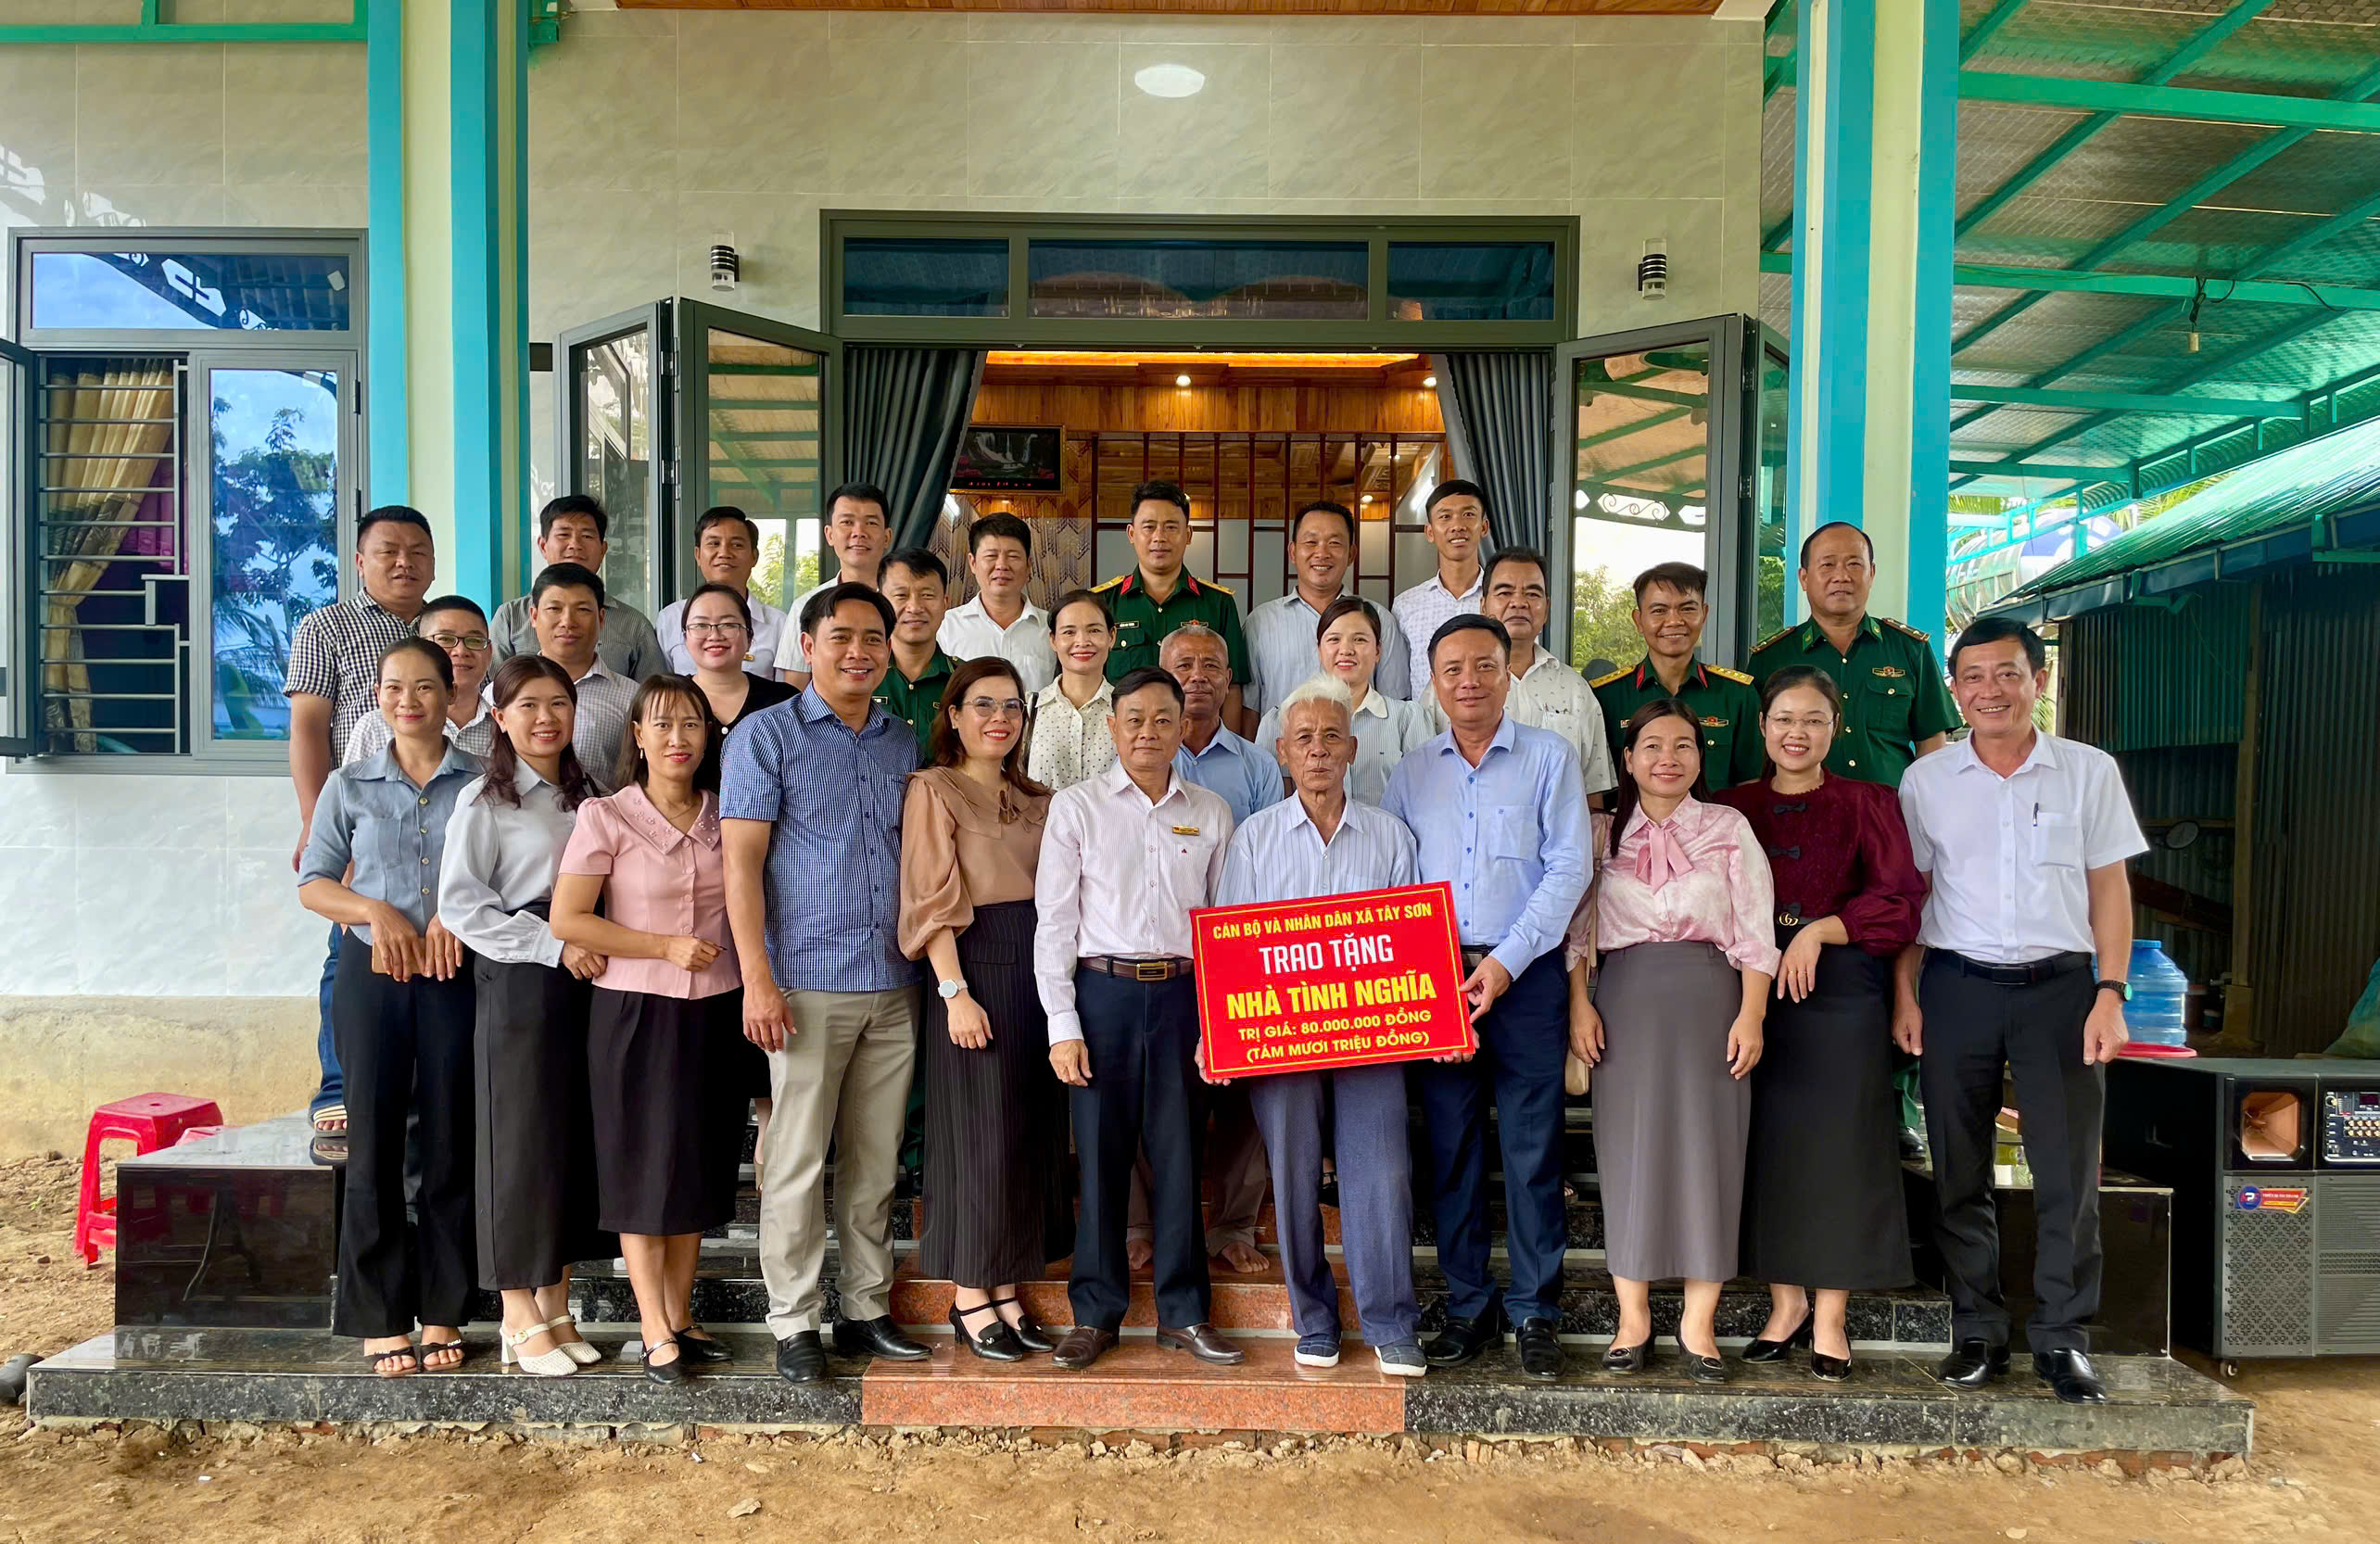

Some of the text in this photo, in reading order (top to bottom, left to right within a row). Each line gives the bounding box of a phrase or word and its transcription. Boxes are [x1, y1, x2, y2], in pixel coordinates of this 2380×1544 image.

[1212, 902, 1432, 939] CÁN BỘ VÀ NHÂN DÂN XÃ TÂY SƠN
[1258, 932, 1394, 974] TRAO TẶNG
[1225, 968, 1437, 1019] NHÀ TÌNH NGHĨA
[1237, 1006, 1432, 1042] TRỊ GIÁ: 80.000.000 ĐỒNG
[1246, 1028, 1430, 1063] (TÁM MƯƠI TRIỆU ĐỒNG)
